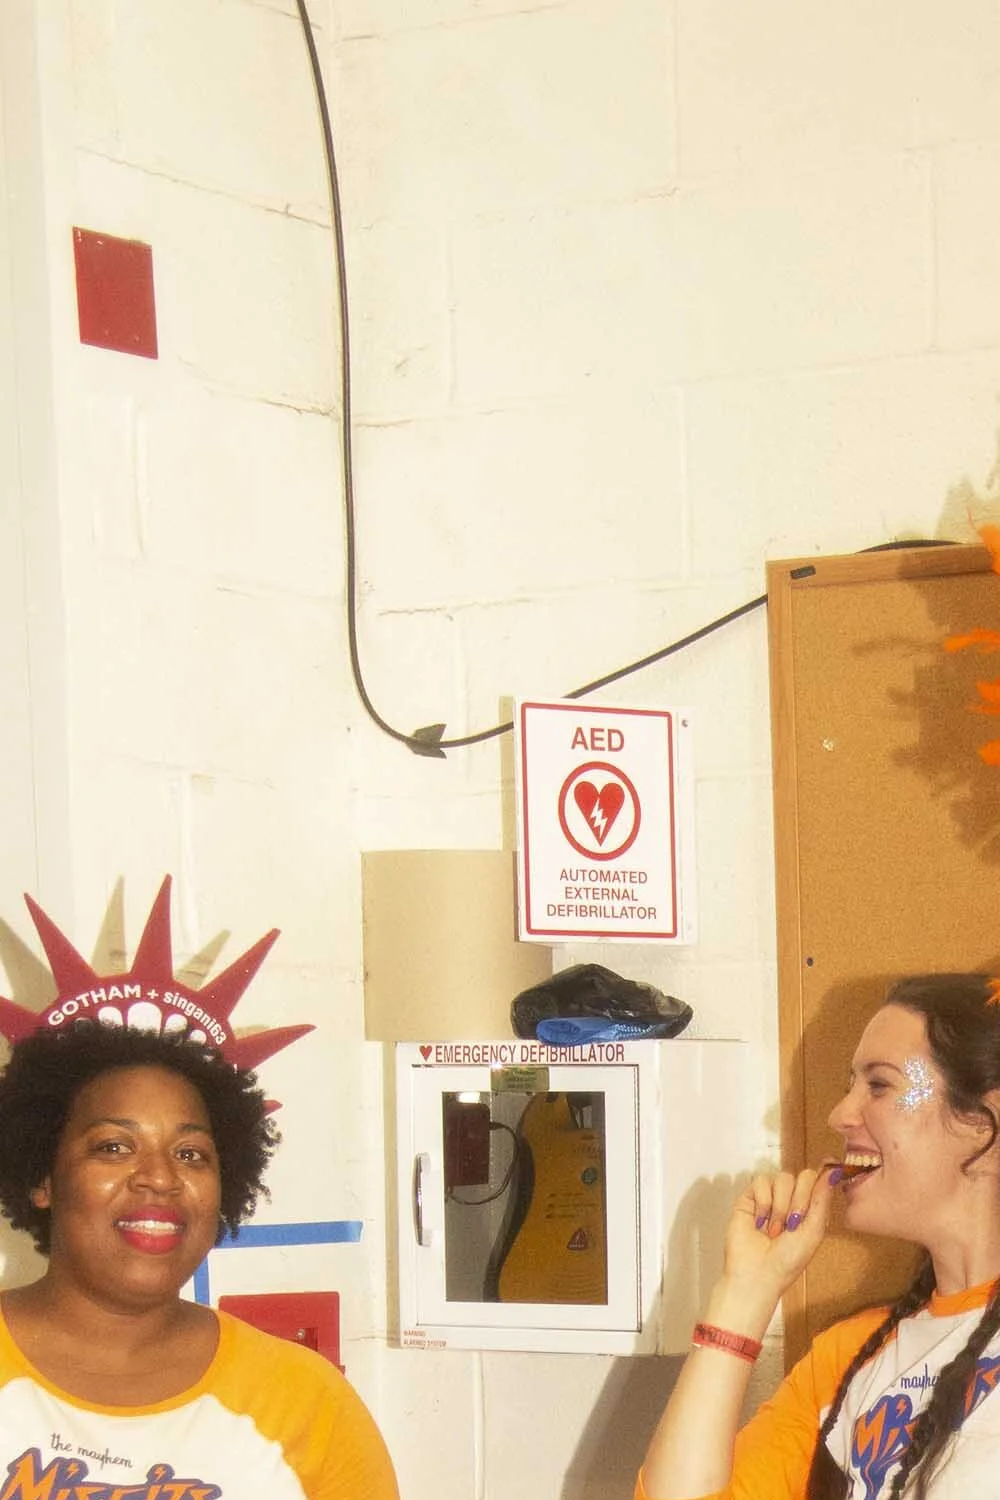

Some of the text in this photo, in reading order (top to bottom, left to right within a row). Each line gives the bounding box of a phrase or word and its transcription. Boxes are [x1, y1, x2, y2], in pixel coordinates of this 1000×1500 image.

[571, 726, 625, 752] AED
[559, 868, 648, 884] AUTOMATED
[565, 886, 639, 902] EXTERNAL
[546, 903, 657, 920] DEFIBRILLATOR
[47, 983, 141, 1027] GOTHAM
[163, 990, 227, 1046] singani63
[435, 1043, 625, 1064] EMERGENCY DEFIBRILLATOR
[901, 1363, 939, 1401] mayhe
[50, 1433, 133, 1469] the mayhem
